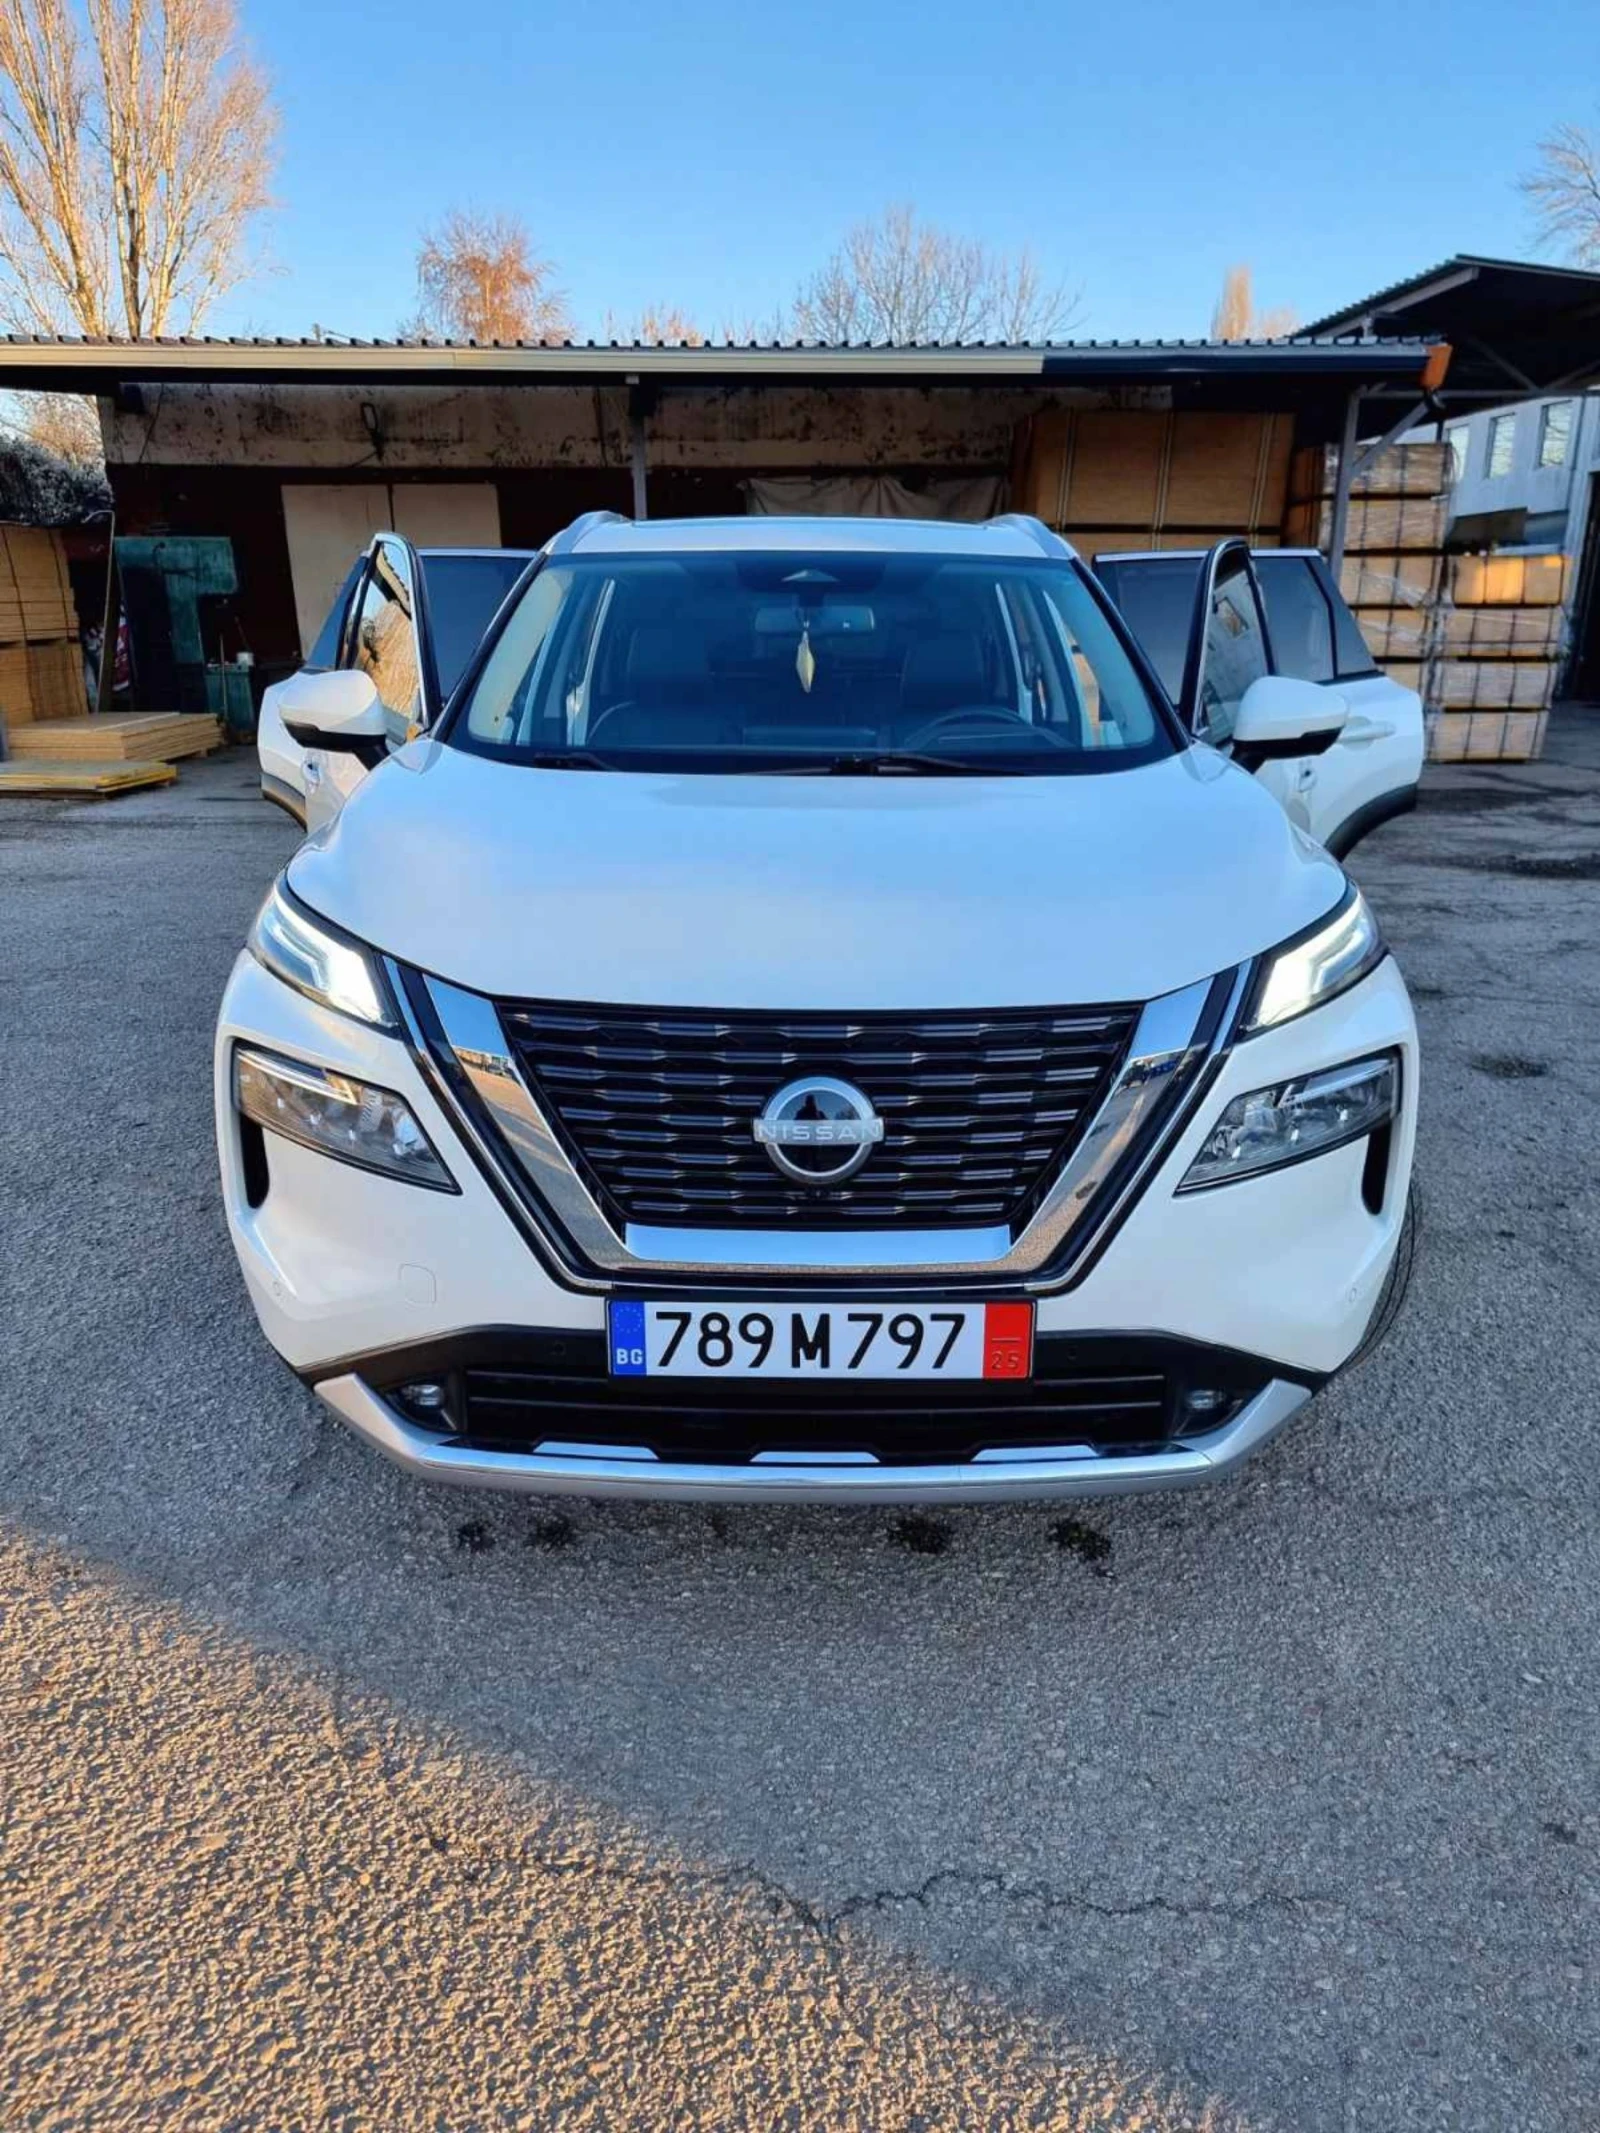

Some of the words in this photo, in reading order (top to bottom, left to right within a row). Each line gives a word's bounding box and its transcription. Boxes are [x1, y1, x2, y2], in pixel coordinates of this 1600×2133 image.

[758, 1124, 880, 1141] NISSAN
[656, 1311, 774, 1368] 789
[791, 1313, 830, 1369] M
[847, 1313, 966, 1369] 797
[616, 1348, 643, 1365] BG
[992, 1349, 1019, 1369] 25
